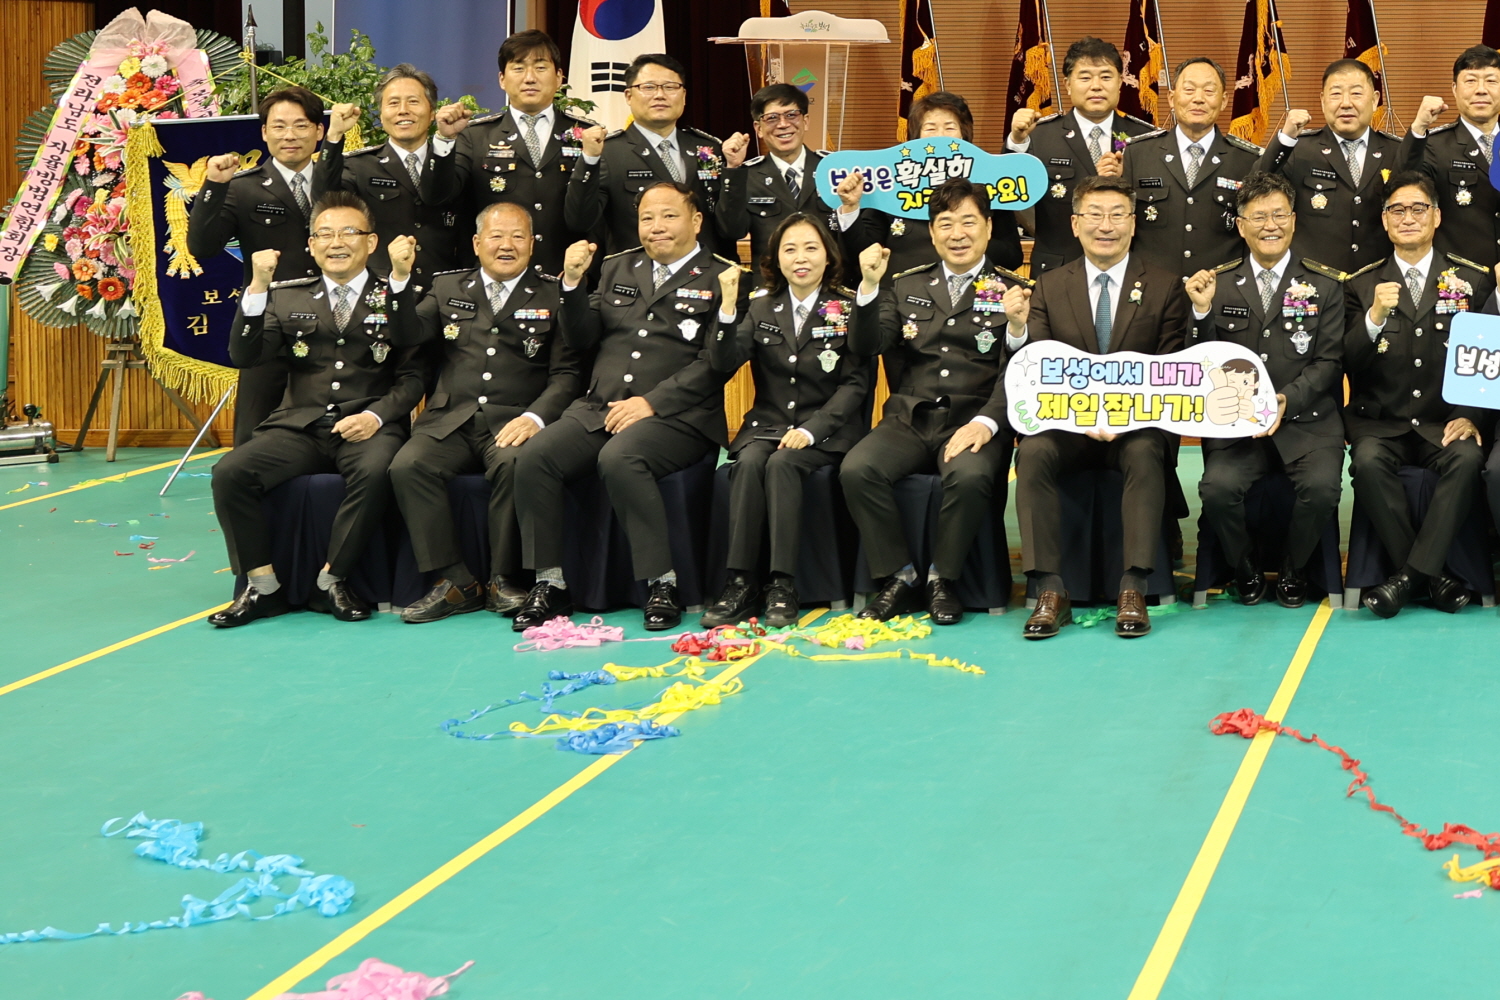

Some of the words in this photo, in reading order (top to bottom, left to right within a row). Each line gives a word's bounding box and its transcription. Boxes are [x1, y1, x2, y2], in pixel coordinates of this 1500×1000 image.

[56, 73, 102, 133] 전라남도
[895, 154, 973, 188] 확실히
[1, 140, 70, 262] 자율방범연합회장
[1041, 358, 1144, 389] 보성에서
[1150, 361, 1203, 387] 내가
[1036, 392, 1099, 427] 제일
[1103, 392, 1205, 427] 잘나가!
